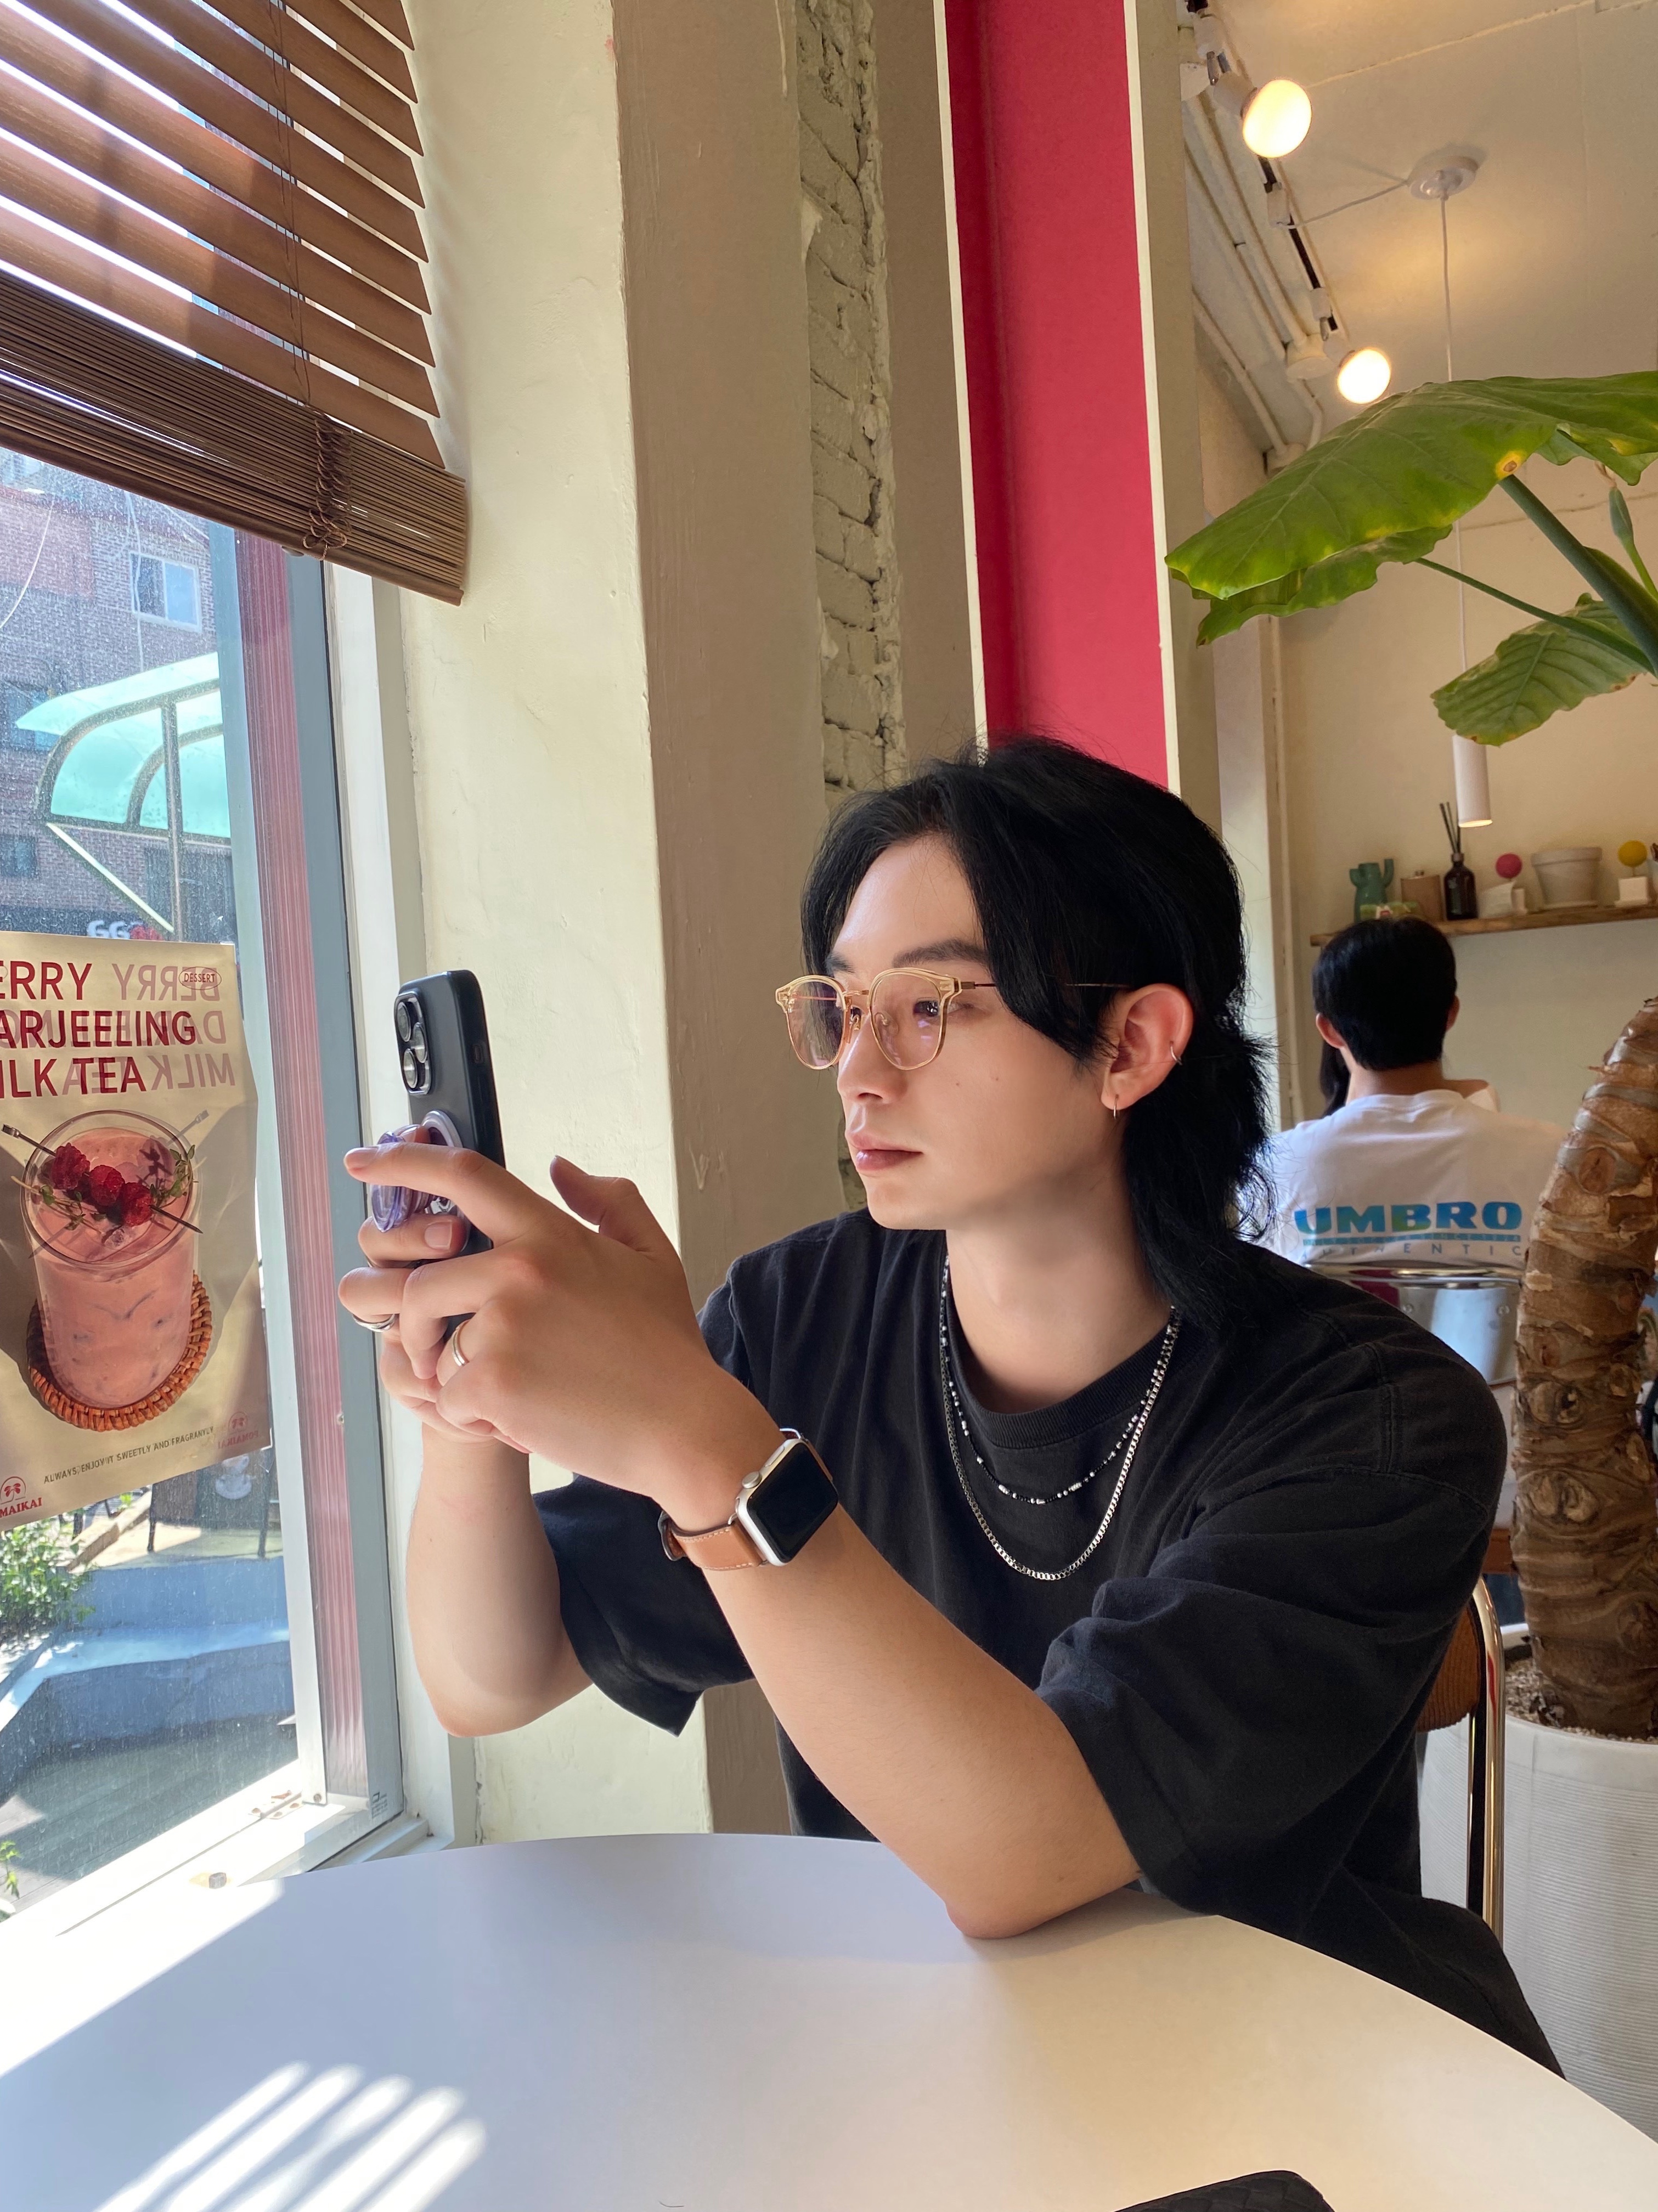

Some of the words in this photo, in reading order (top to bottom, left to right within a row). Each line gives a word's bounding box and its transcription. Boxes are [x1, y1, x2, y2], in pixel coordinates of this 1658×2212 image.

[184, 973, 215, 983] DESSERT
[72, 1057, 146, 1095] TEA
[1294, 1201, 1522, 1234] UMBRO
[81, 1458, 105, 1472] ENJOY
[107, 1455, 114, 1464] IT
[117, 1444, 151, 1462] SWEETLY
[154, 1440, 170, 1451] AND
